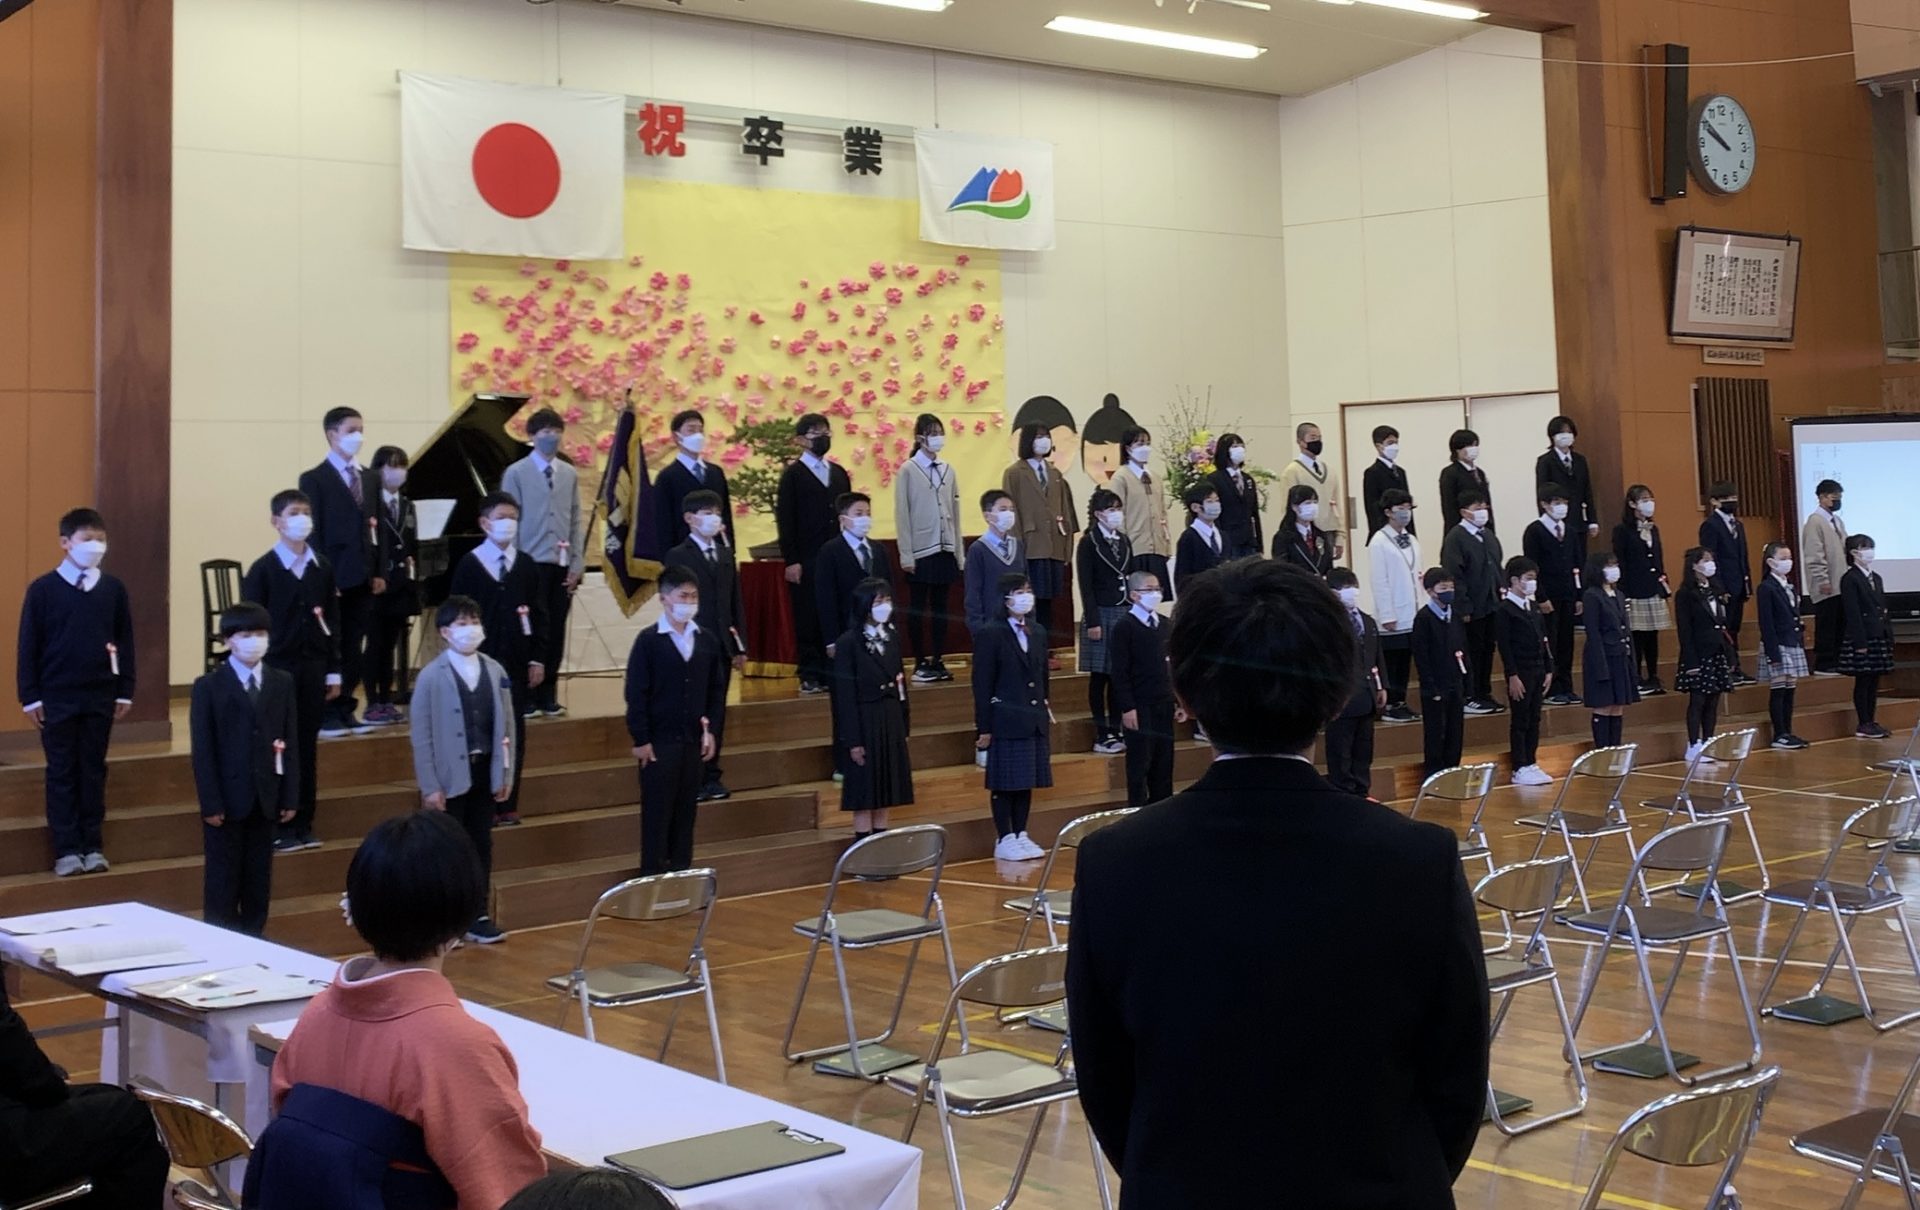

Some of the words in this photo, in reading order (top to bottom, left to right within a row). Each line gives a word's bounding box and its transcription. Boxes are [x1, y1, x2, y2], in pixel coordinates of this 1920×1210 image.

[1708, 108, 1716, 119] 11
[1717, 104, 1726, 116] 12
[1737, 123, 1744, 135] 2
[1700, 137, 1705, 148] 9
[1741, 142, 1747, 152] 3
[1703, 155, 1709, 167] 8
[1739, 159, 1745, 169] 4
[1712, 168, 1718, 180] 7
[1723, 174, 1728, 185] 6
[1732, 171, 1738, 182] 5
